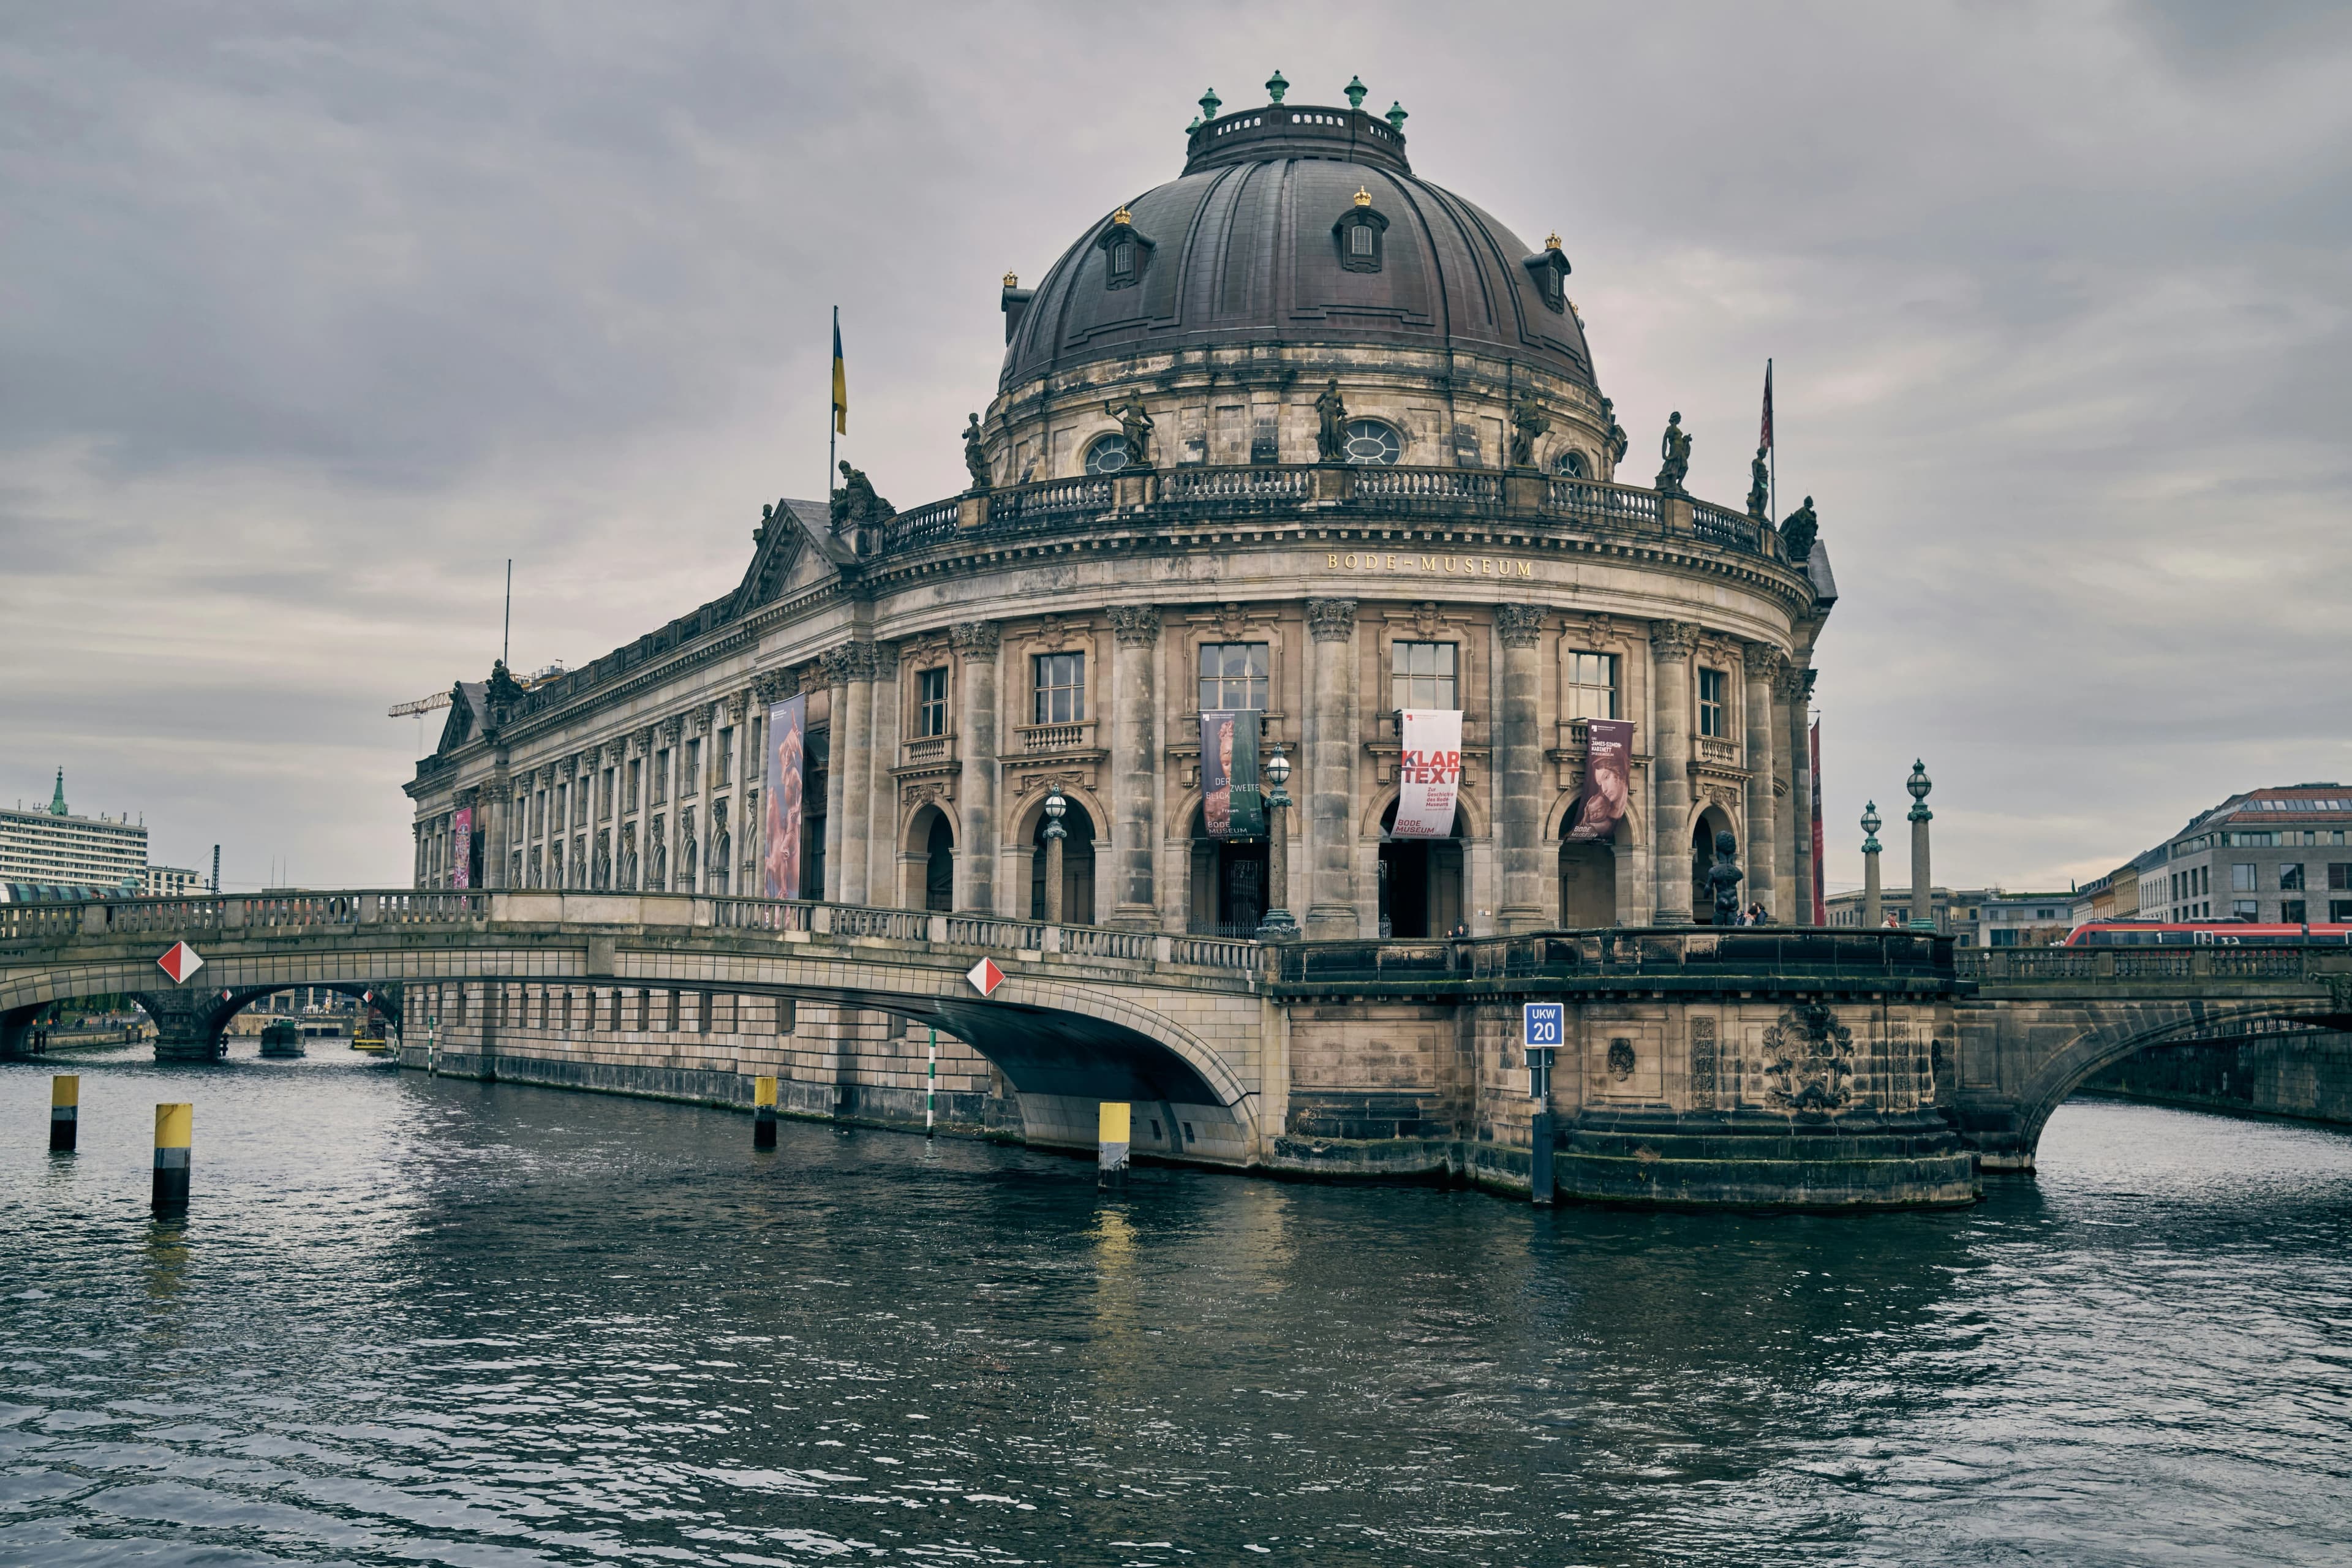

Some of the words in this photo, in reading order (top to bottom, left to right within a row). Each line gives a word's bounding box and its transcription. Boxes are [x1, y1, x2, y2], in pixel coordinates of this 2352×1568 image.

[1327, 554, 1532, 576] BODE-MUSEUM
[1401, 750, 1460, 767] KLAR
[1401, 767, 1460, 784] TEXT
[2156, 932, 2163, 944] 1
[1532, 1009, 1556, 1019] UKW
[1534, 1022, 1555, 1041] 20
